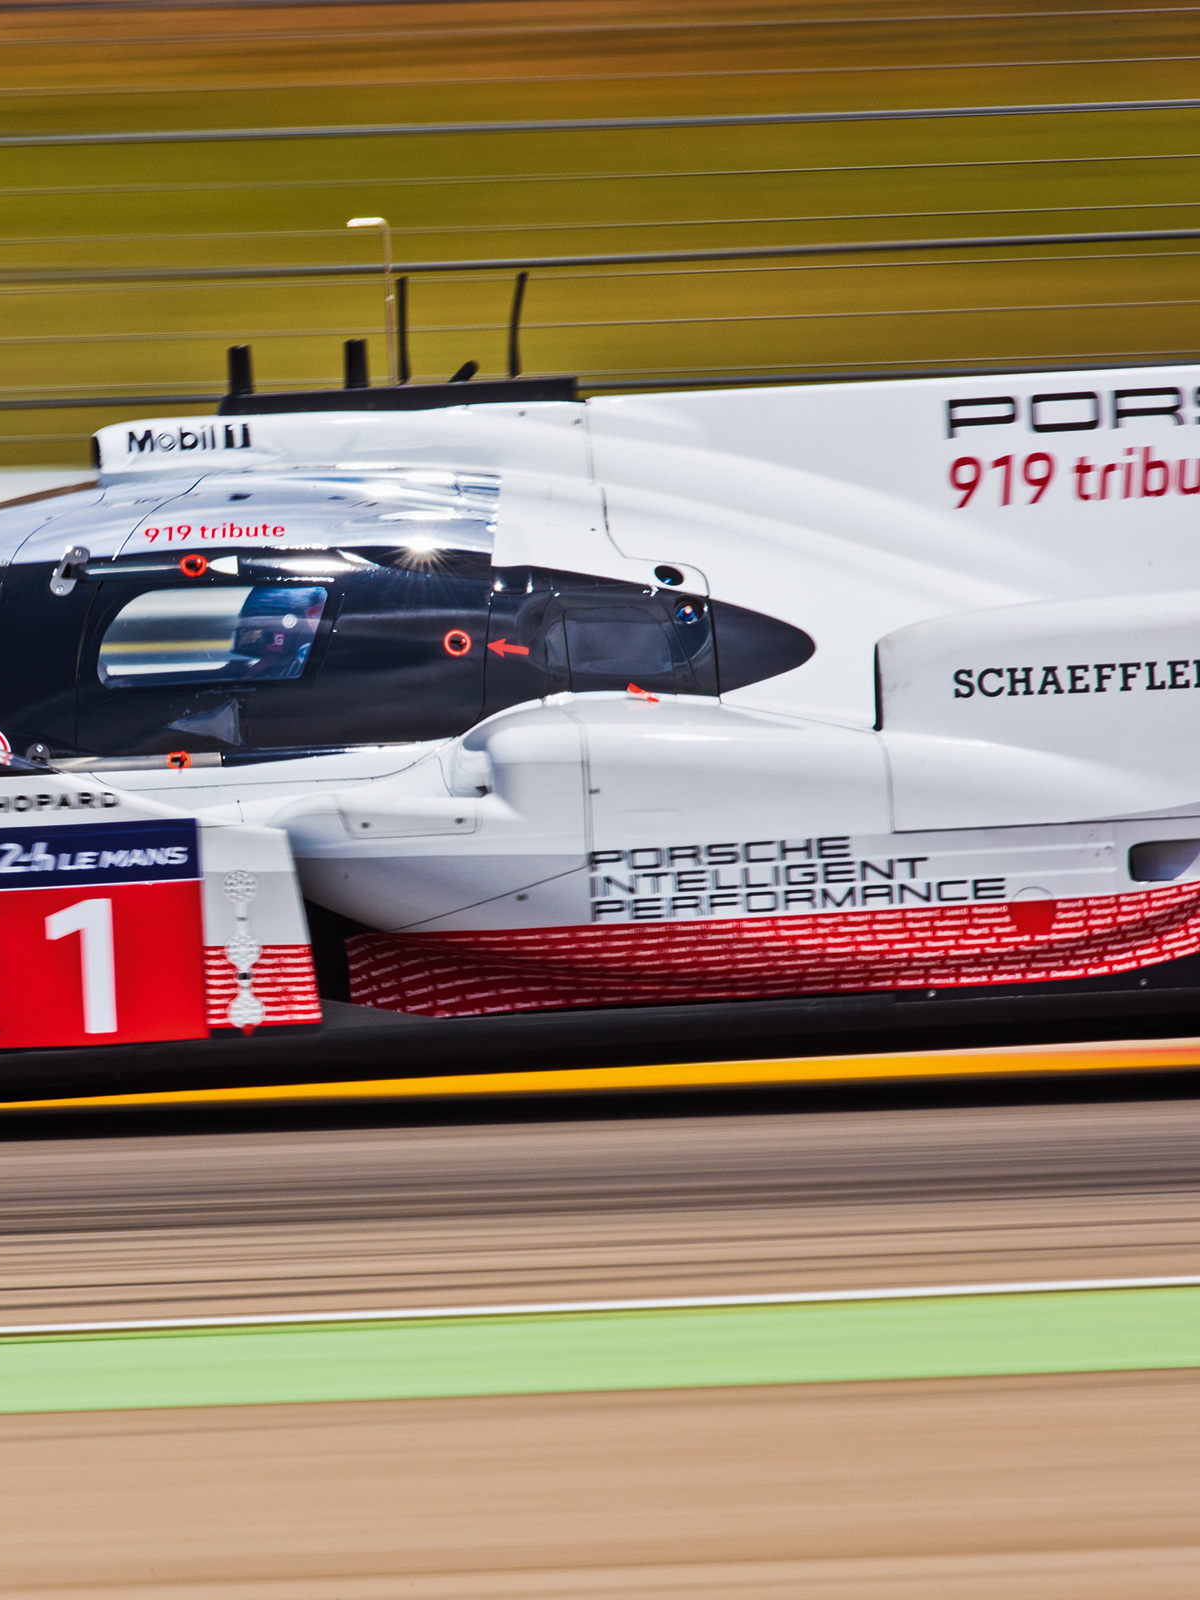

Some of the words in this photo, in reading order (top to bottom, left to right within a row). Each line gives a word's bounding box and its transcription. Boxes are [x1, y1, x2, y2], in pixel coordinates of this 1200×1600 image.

[946, 384, 1200, 439] POR
[128, 425, 216, 453] Mobil
[949, 451, 1055, 509] 919
[145, 525, 191, 543] 919
[200, 522, 286, 540] tribute
[99, 846, 188, 868] MANS
[591, 836, 851, 867] PORSCHE
[590, 857, 928, 896] INTELLIGENT
[592, 878, 1007, 921] PERFORMANCE
[44, 897, 118, 1034] 1
